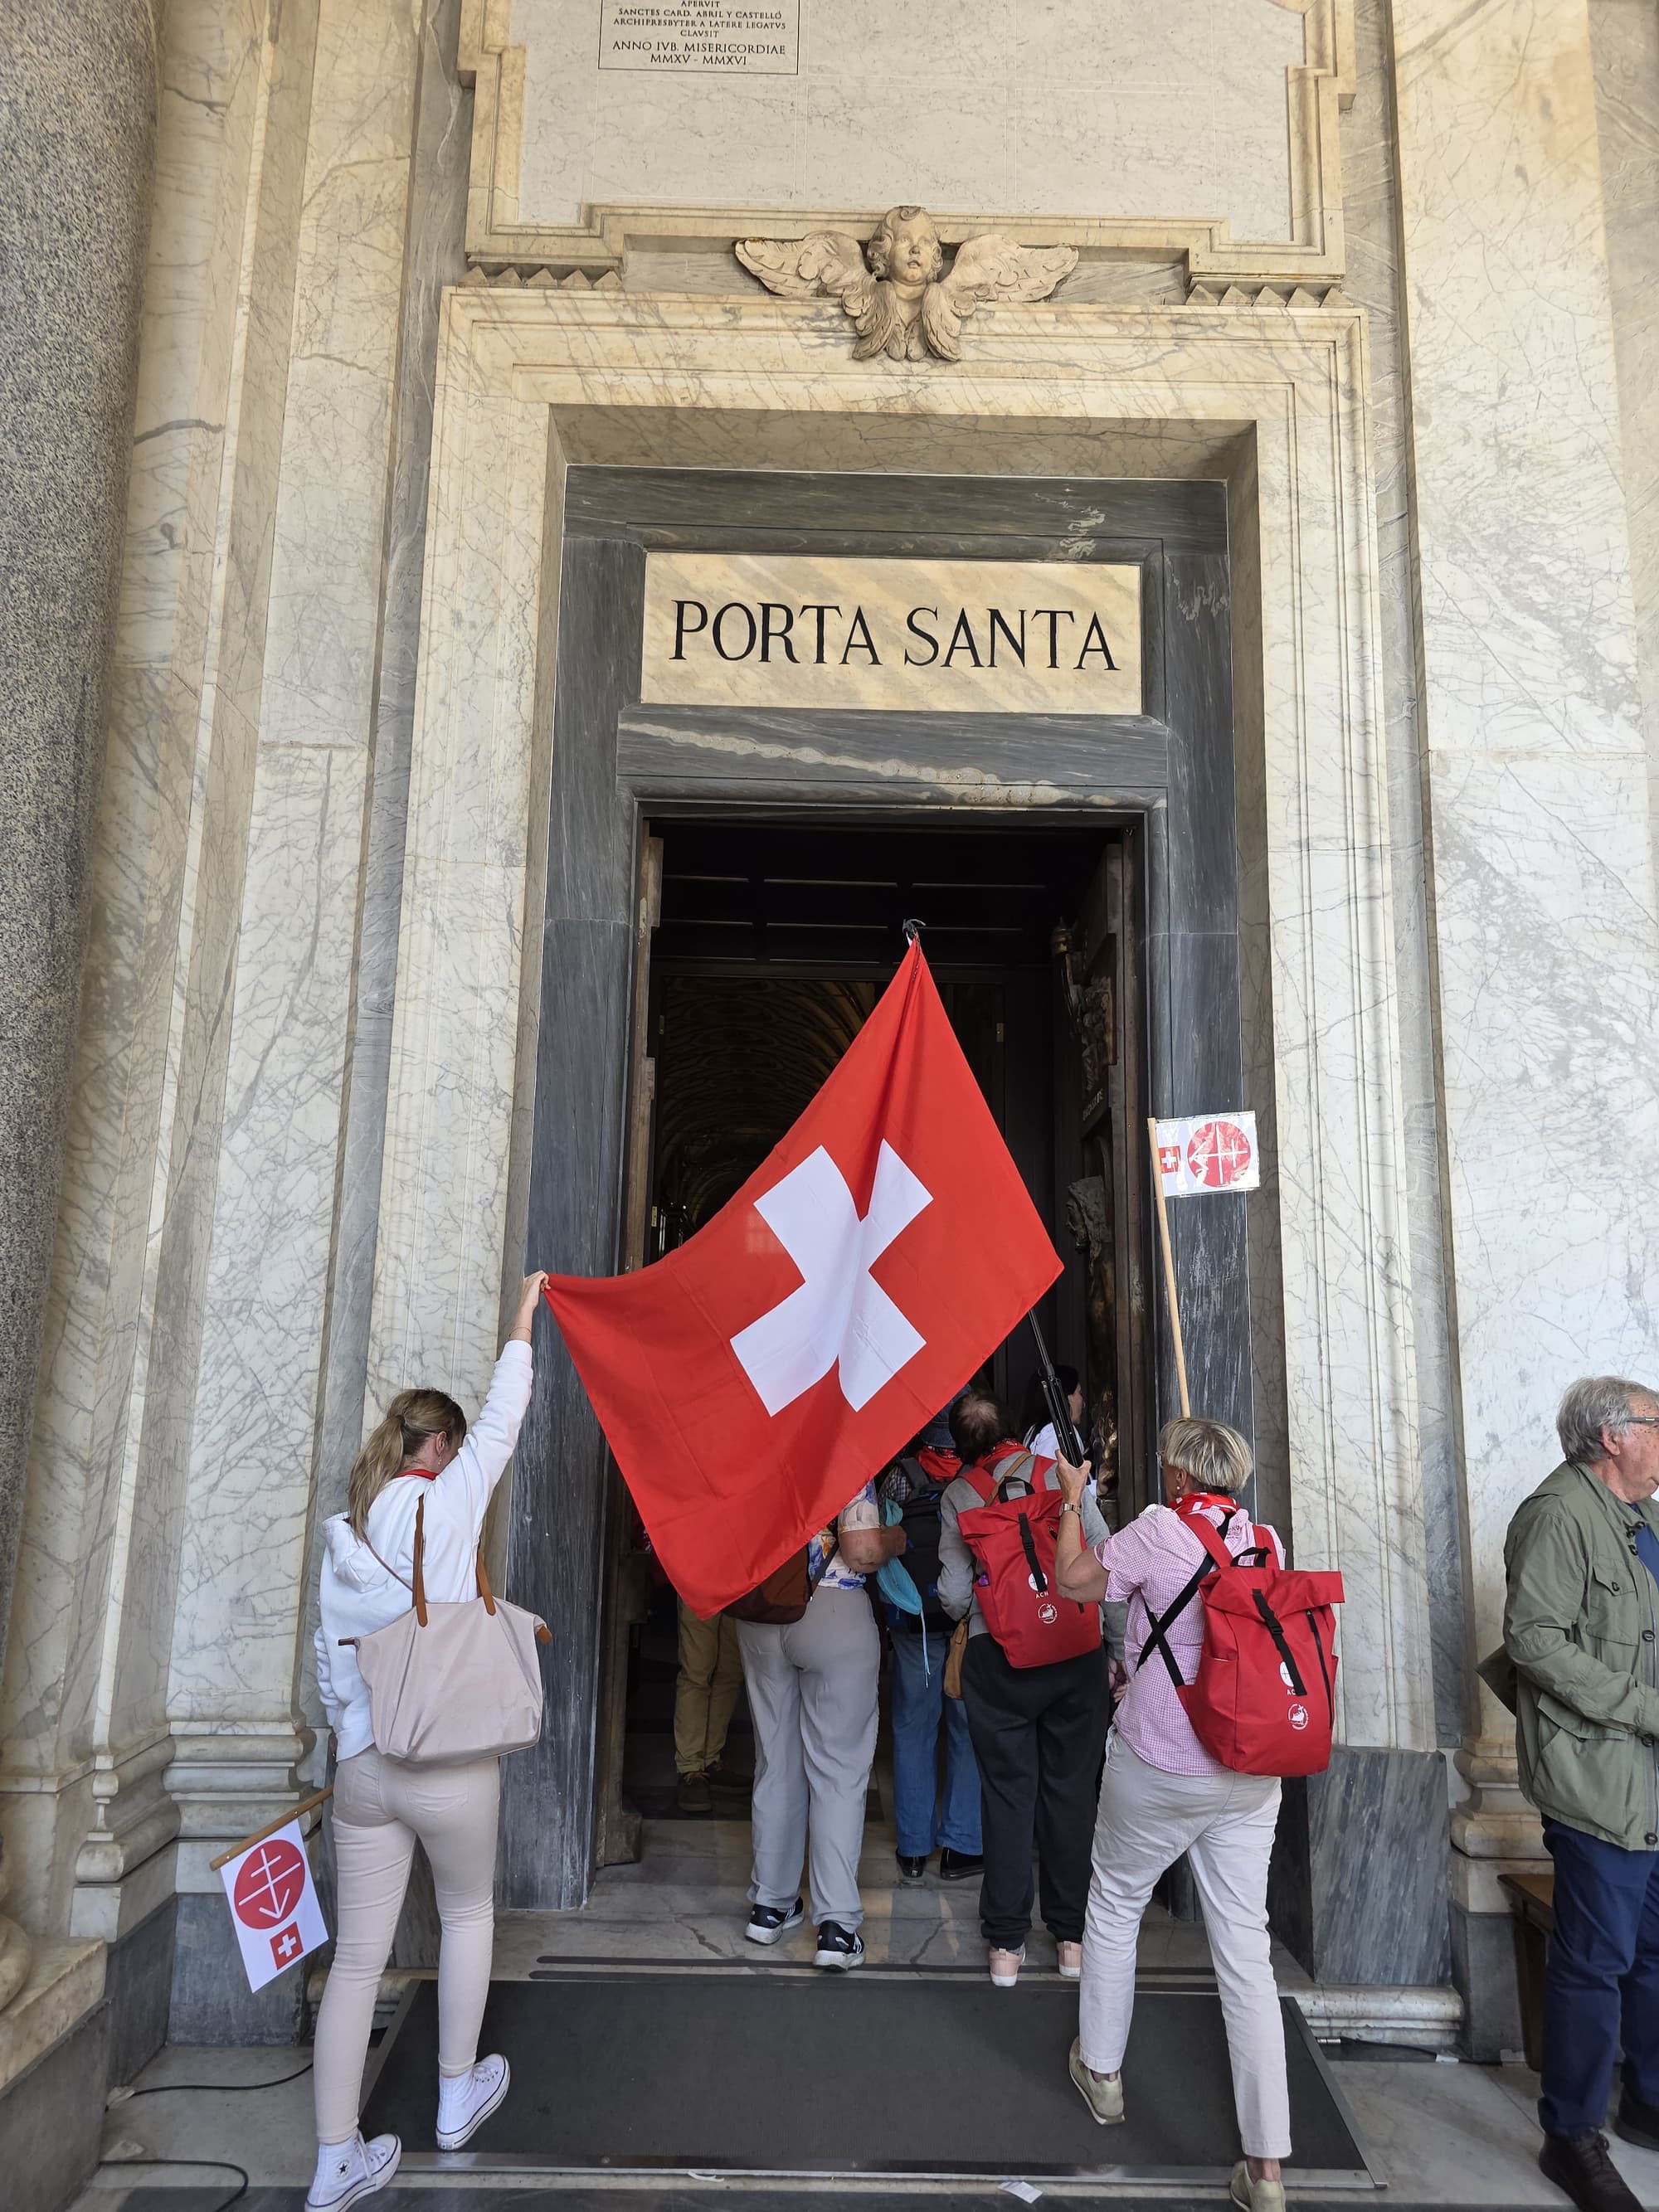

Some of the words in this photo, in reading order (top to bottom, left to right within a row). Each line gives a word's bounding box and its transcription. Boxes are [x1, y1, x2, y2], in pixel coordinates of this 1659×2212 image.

[736, 11, 781, 19] CASTELLÓ
[614, 17, 697, 27] ARCHIPRESBYTER
[680, 29, 719, 38] CLAVSIT
[613, 41, 651, 51] ANNO
[657, 41, 679, 51] IVB.
[684, 42, 786, 55] MISERICORDIAE
[650, 54, 690, 63] MMXV
[703, 55, 747, 66] MMXVI
[669, 600, 883, 665] PORTA
[904, 606, 1121, 670] SANTA
